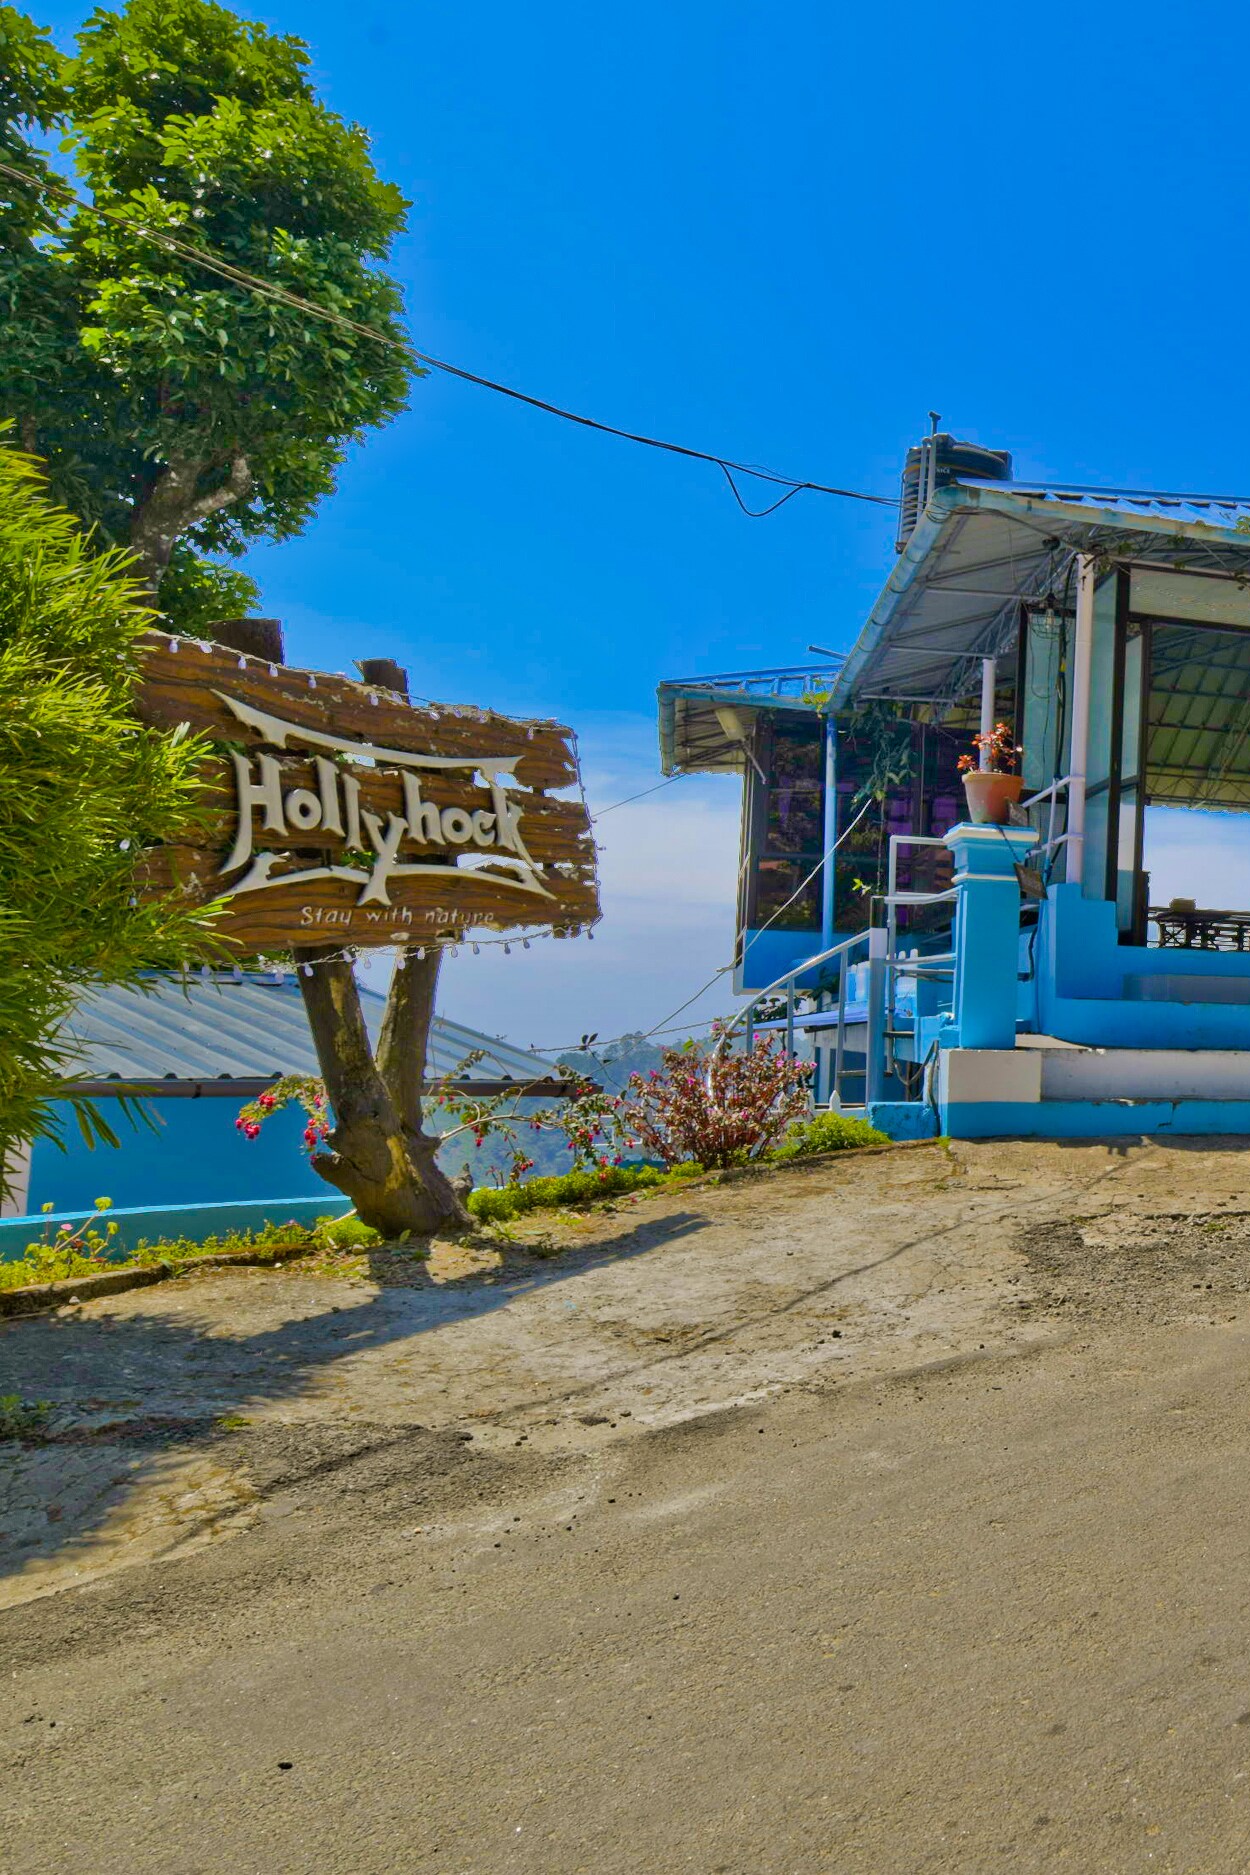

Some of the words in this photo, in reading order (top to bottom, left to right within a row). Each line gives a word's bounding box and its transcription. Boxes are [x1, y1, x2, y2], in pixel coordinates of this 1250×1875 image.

[219, 749, 549, 906] Hollyhock
[300, 906, 352, 925] Stay
[366, 907, 413, 925] with
[425, 907, 495, 925] nature
